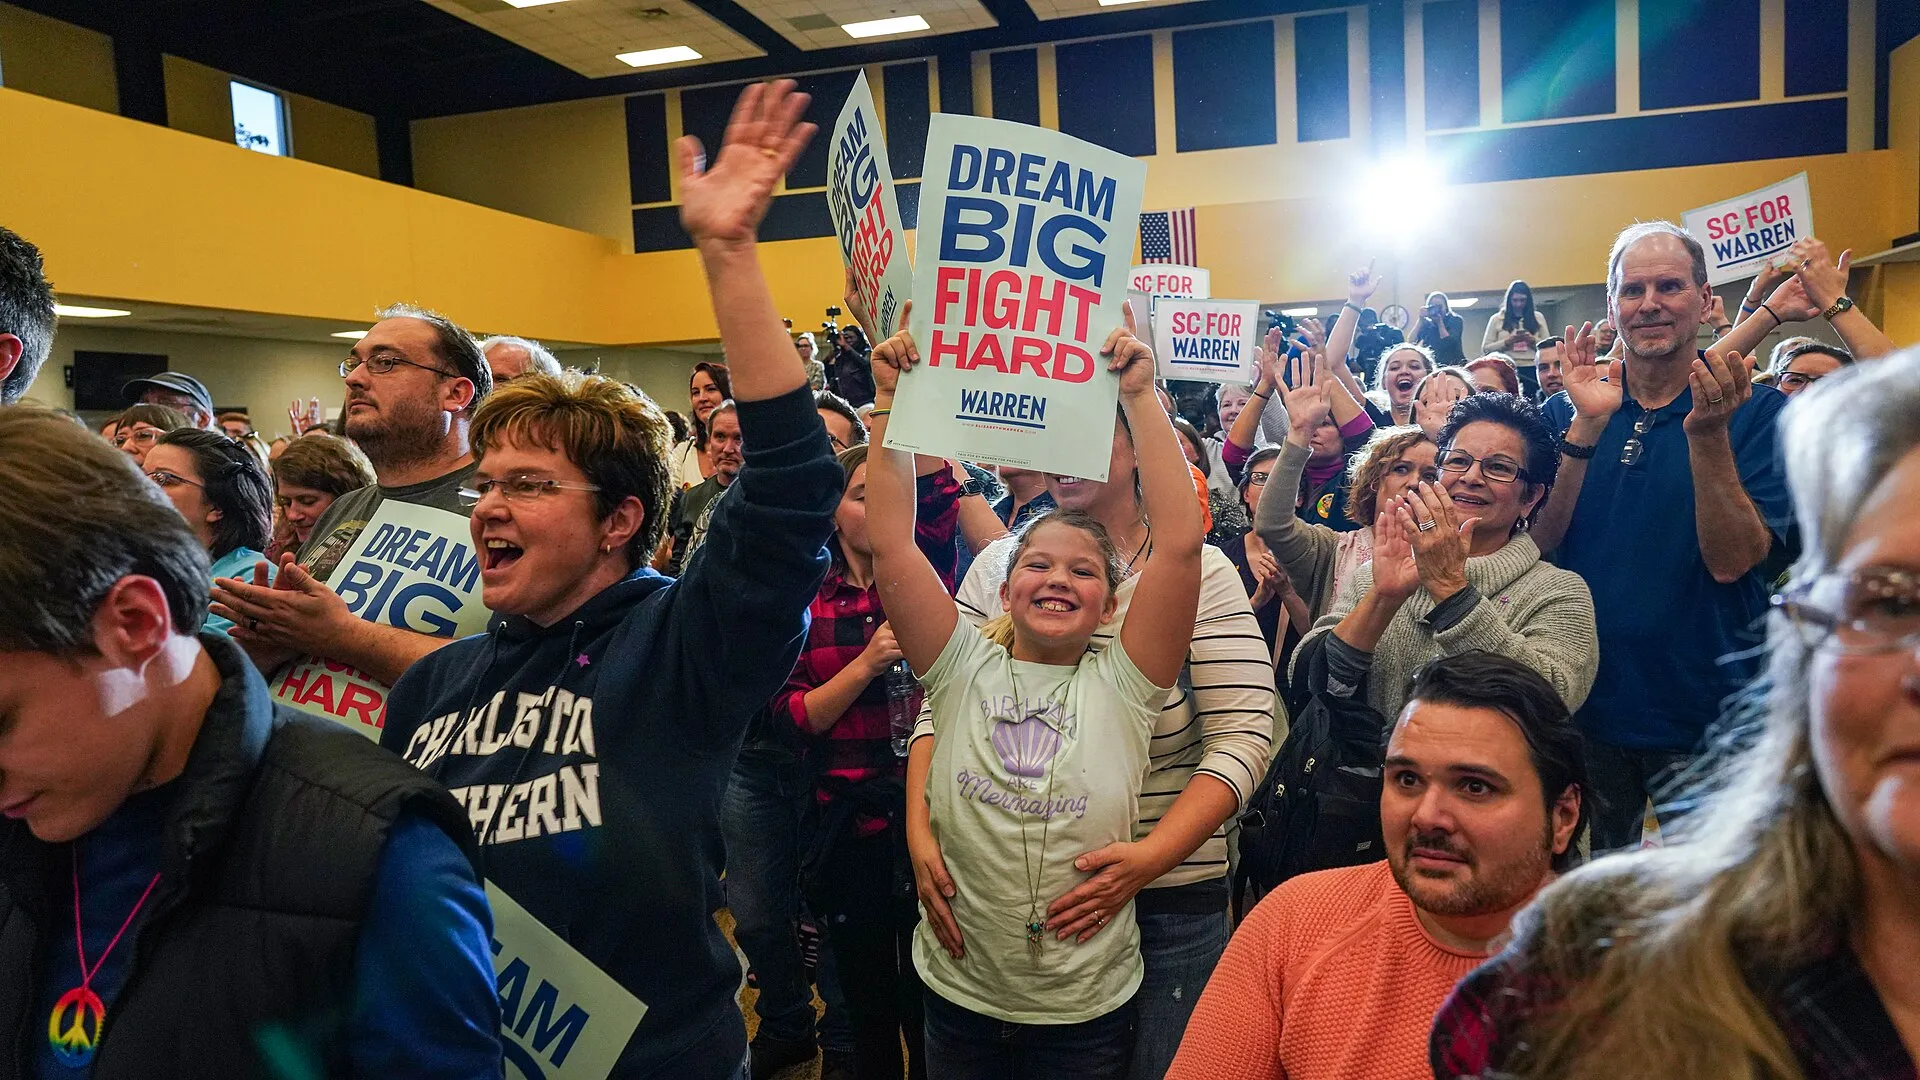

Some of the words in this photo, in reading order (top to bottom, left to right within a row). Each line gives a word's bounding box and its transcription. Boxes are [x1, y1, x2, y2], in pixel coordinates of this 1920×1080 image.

[832, 106, 868, 223] DREAM
[947, 144, 1117, 222] DREAM
[839, 142, 879, 264] BIG
[1706, 212, 1741, 240] SC
[1744, 195, 1792, 230] FOR
[852, 182, 886, 305] FIGHT
[939, 195, 1108, 289] BIG
[1712, 218, 1796, 262] WARREN
[867, 228, 894, 332] HARD
[933, 266, 1102, 344] FIGHT
[1133, 275, 1153, 293] SC
[1157, 274, 1193, 294] FOR
[929, 329, 1095, 384] HARD
[1171, 311, 1200, 335] SC
[1206, 312, 1242, 337] FOR
[1172, 337, 1240, 362] WARREN
[961, 388, 1047, 422] WARREN
[360, 523, 481, 594] DREAM
[334, 560, 464, 638] BIG
[277, 665, 388, 729] HAR
[956, 769, 1088, 820] Mermazing
[491, 938, 590, 1069] AM
